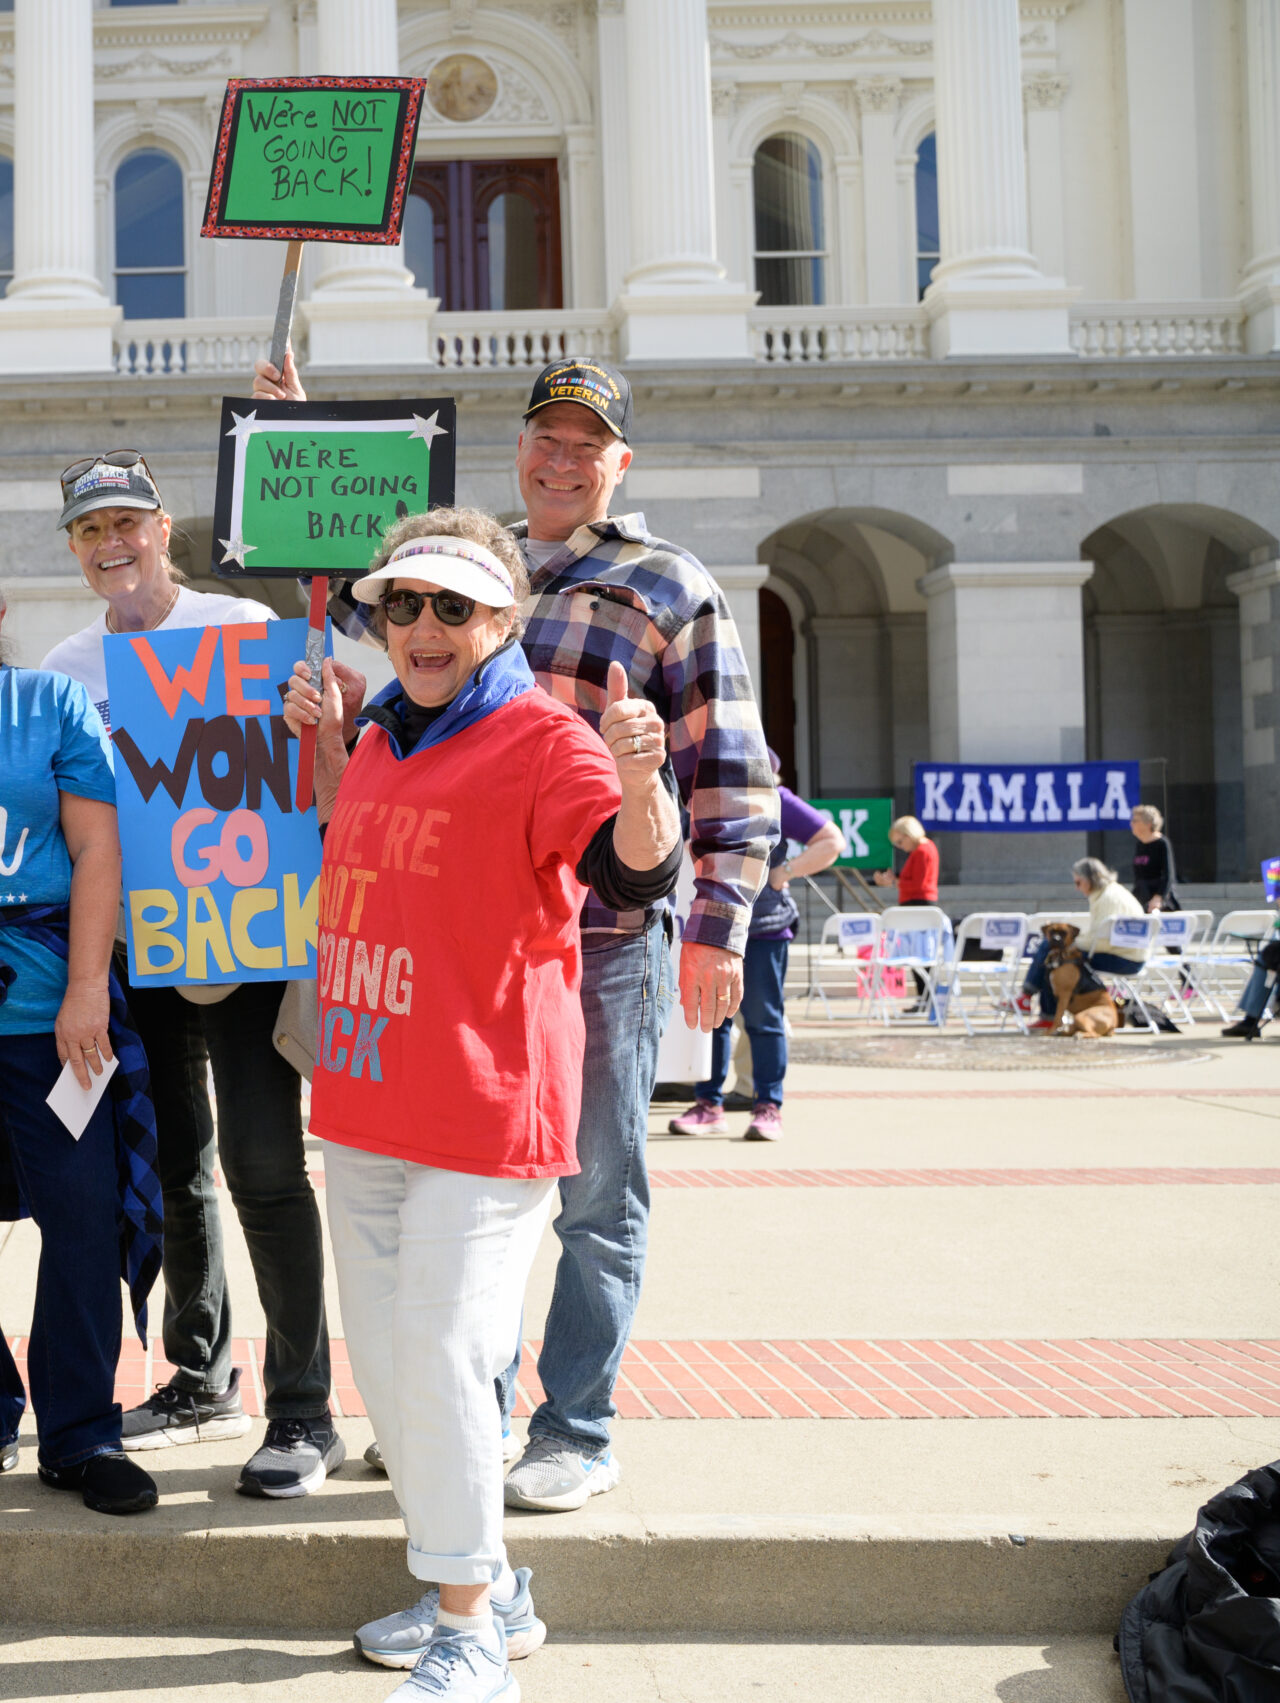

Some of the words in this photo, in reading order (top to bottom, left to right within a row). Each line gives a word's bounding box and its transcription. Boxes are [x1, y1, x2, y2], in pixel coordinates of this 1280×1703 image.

[246, 96, 318, 132] We're
[331, 99, 387, 129] NOT
[263, 135, 348, 163] GOING
[271, 145, 373, 201] BACK!
[549, 385, 611, 411] VETERAN
[607, 377, 621, 400] WAR
[265, 439, 359, 470] WE'RE
[260, 475, 321, 502] NOT
[330, 475, 418, 496] GOING
[128, 622, 271, 720] WE
[921, 770, 1132, 823] KAMALA
[171, 807, 269, 887] GO
